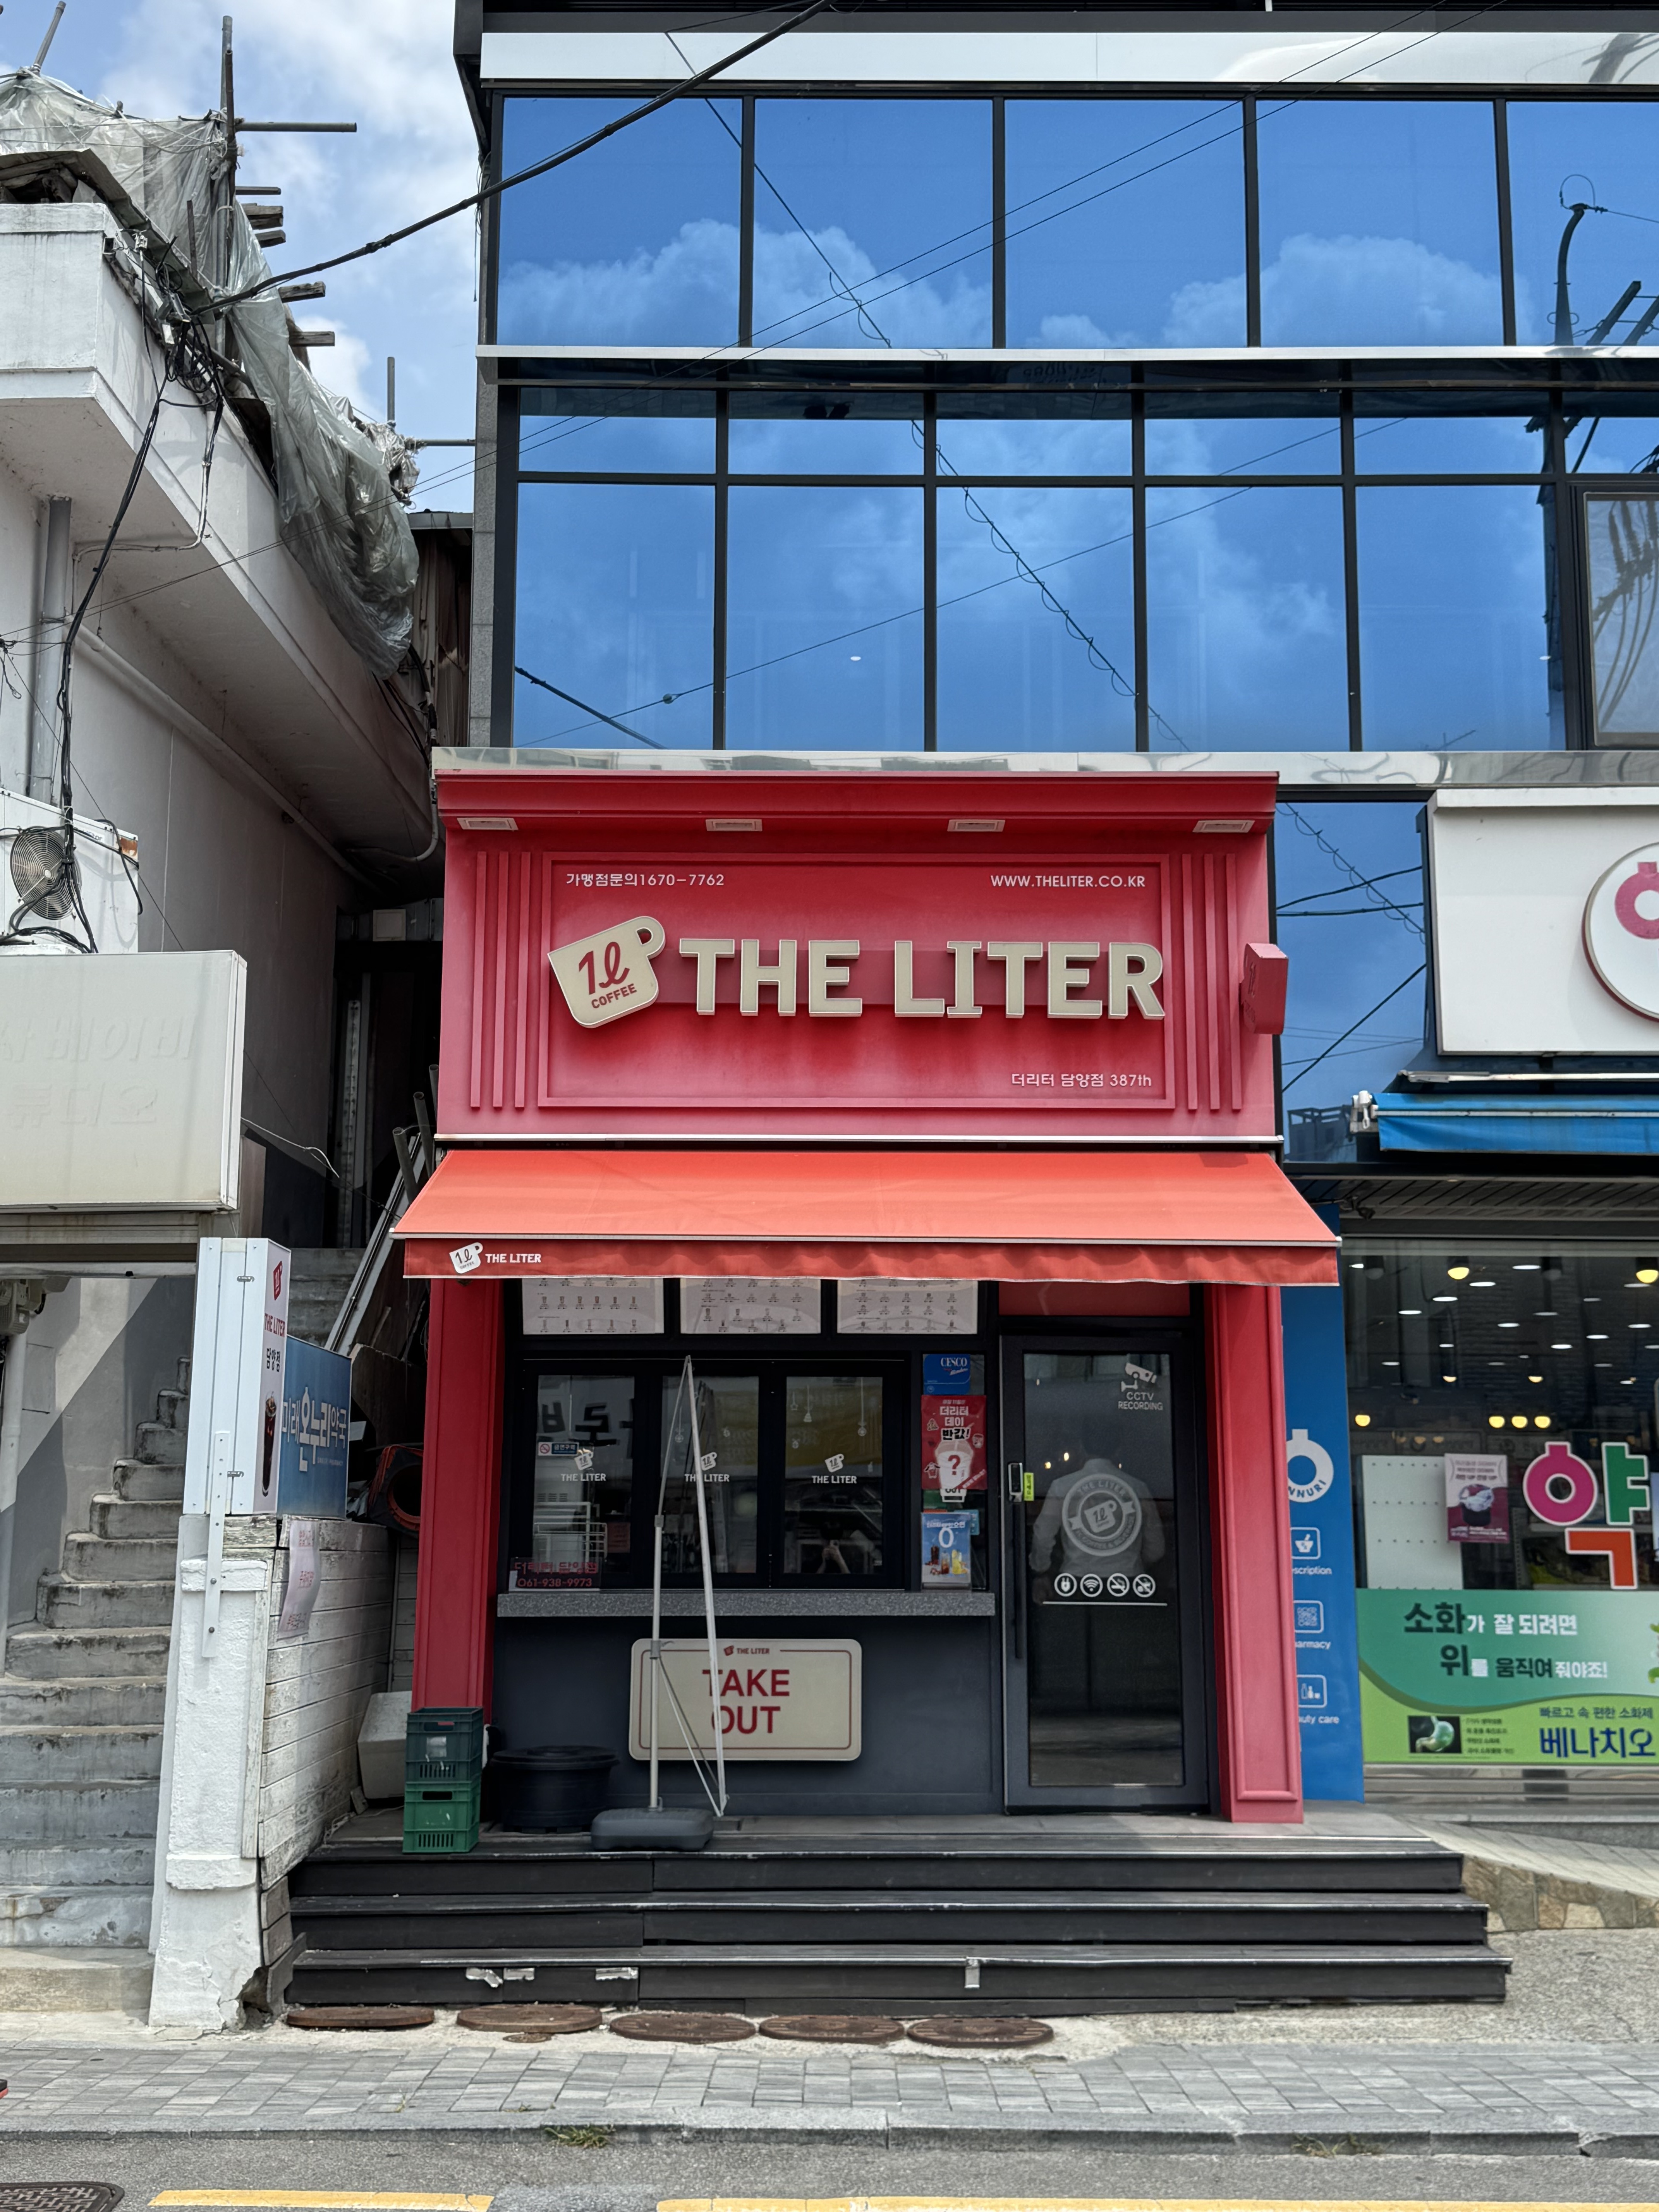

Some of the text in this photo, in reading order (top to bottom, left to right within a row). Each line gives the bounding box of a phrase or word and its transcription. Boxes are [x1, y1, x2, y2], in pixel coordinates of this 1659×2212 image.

[990, 875, 1145, 887] WWW.THELITER.CO.KR
[679, 938, 1165, 1020] THE LITER
[591, 983, 637, 1009] COFFEE
[1012, 1073, 1152, 1088] 더리터 담양점 387th
[485, 1254, 541, 1263] THE LITER
[264, 1313, 285, 1338] THE LITER
[266, 1348, 281, 1373] 담양점
[940, 1357, 968, 1367] CESCO
[1126, 1391, 1154, 1401] CCTV
[939, 1406, 969, 1416] 더리터
[1118, 1401, 1163, 1411] RECORDING
[561, 1473, 606, 1482] THE LITER
[684, 1474, 730, 1482] TH LITER
[812, 1475, 857, 1484] THE LITER
[1522, 1441, 1650, 1589] 약
[1292, 1565, 1333, 1575] scription
[517, 1577, 592, 1587] 061-938-9973
[1404, 1602, 1578, 1635] 소화가 잘 되려면
[1295, 1641, 1331, 1650] armacy
[1495, 1657, 1553, 1678] 움직여
[702, 1669, 790, 1697] TAKE
[1618, 1707, 1654, 1719] 소화제
[711, 1705, 781, 1735] OUT
[1539, 1726, 1656, 1758] 베나치오
